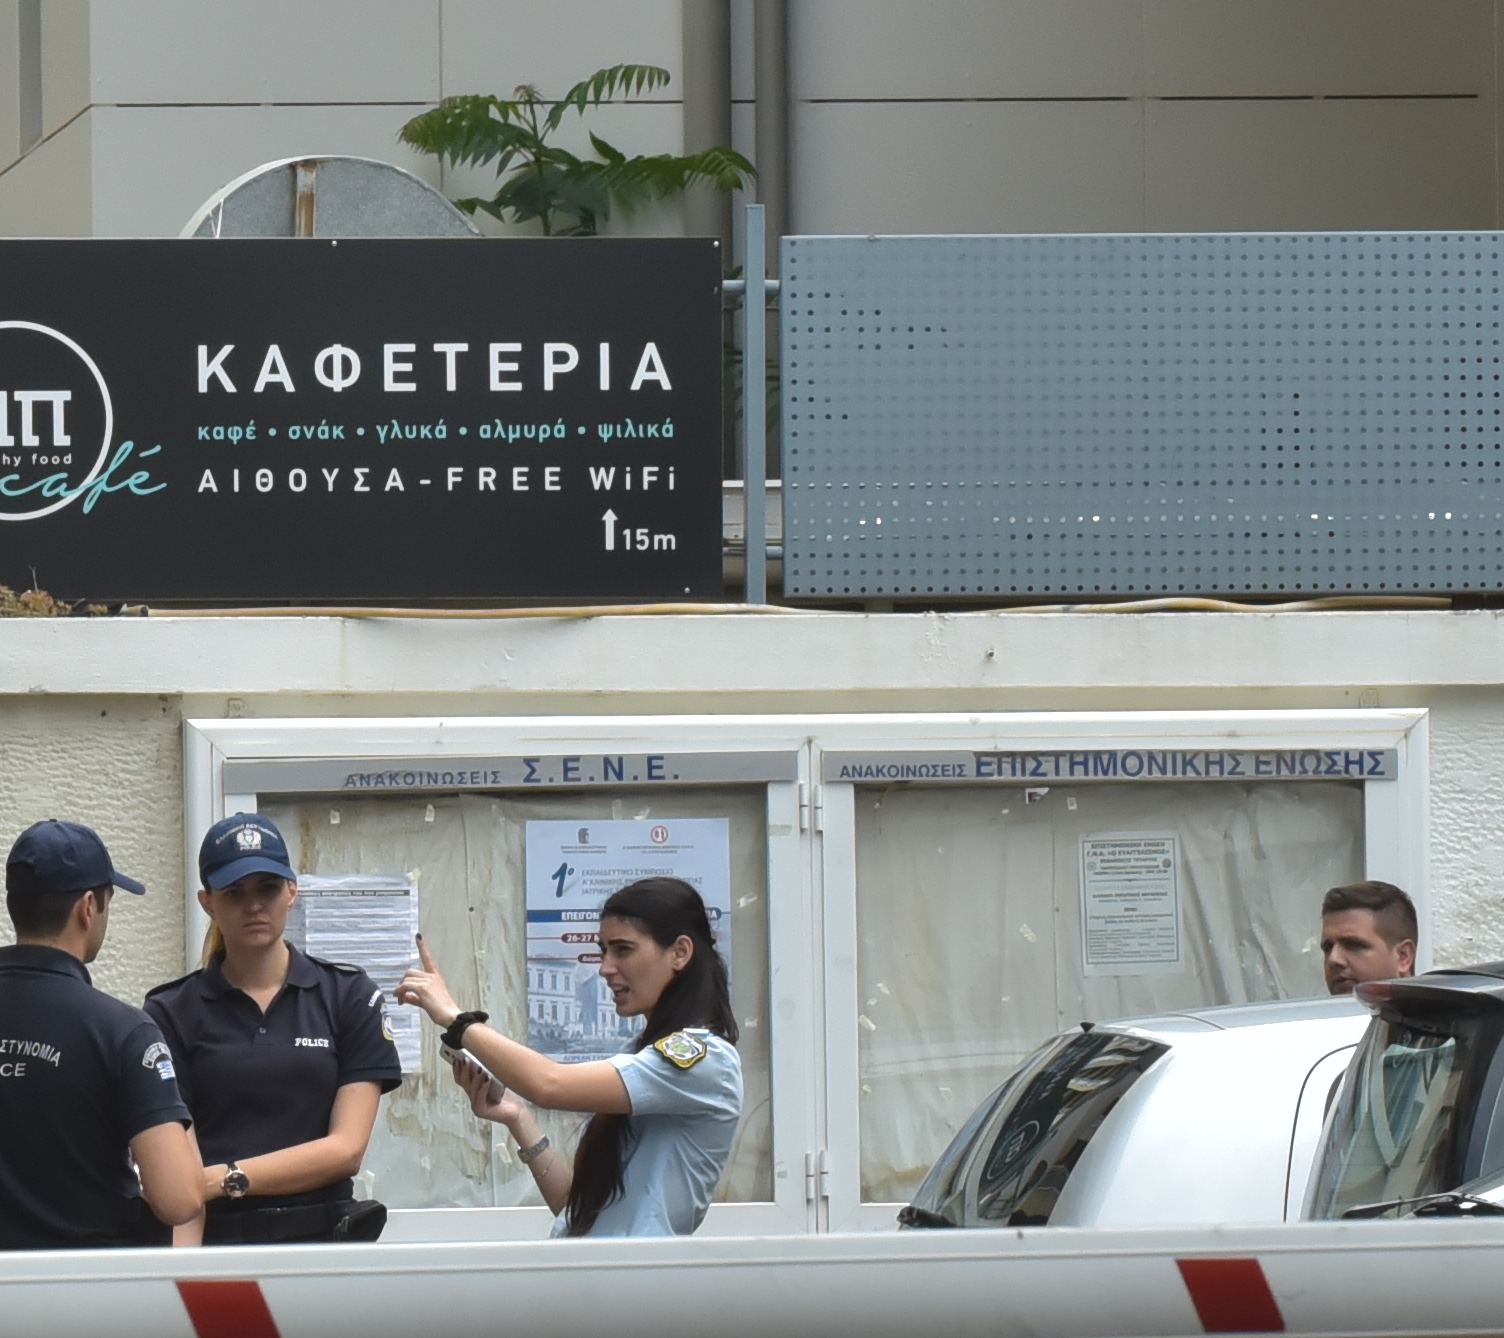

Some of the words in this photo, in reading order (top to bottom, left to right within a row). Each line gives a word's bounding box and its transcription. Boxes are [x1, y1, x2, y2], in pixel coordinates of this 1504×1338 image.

[197, 342, 673, 393] ΚΑΦΕΤΕΡΙΑ
[197, 419, 257, 444] καφέ
[288, 419, 345, 440] σνάκ
[376, 419, 448, 444] γλυκά
[479, 418, 566, 443] αλμυρά
[597, 417, 674, 443] ψιλικά
[32, 453, 72, 465] food
[590, 466, 676, 492] WiFi
[622, 527, 677, 551] 15m
[344, 770, 502, 788] ΑΝΑΚΟΙΝΩΣΕΙΣ
[522, 755, 679, 784] Σ.Ε.Ν.Ε.
[839, 763, 966, 779] ΑΝΑΚΟΙΝΩΣΕΙΣ
[974, 750, 1246, 778] ΕΠΙΣΤΗΜΟΝΙΚΗΣ
[1255, 749, 1386, 776] ΕΝΩΣΗΣ
[561, 912, 600, 921] ΕΠΕΙΓΟΝ
[294, 1037, 329, 1048] POLICE
